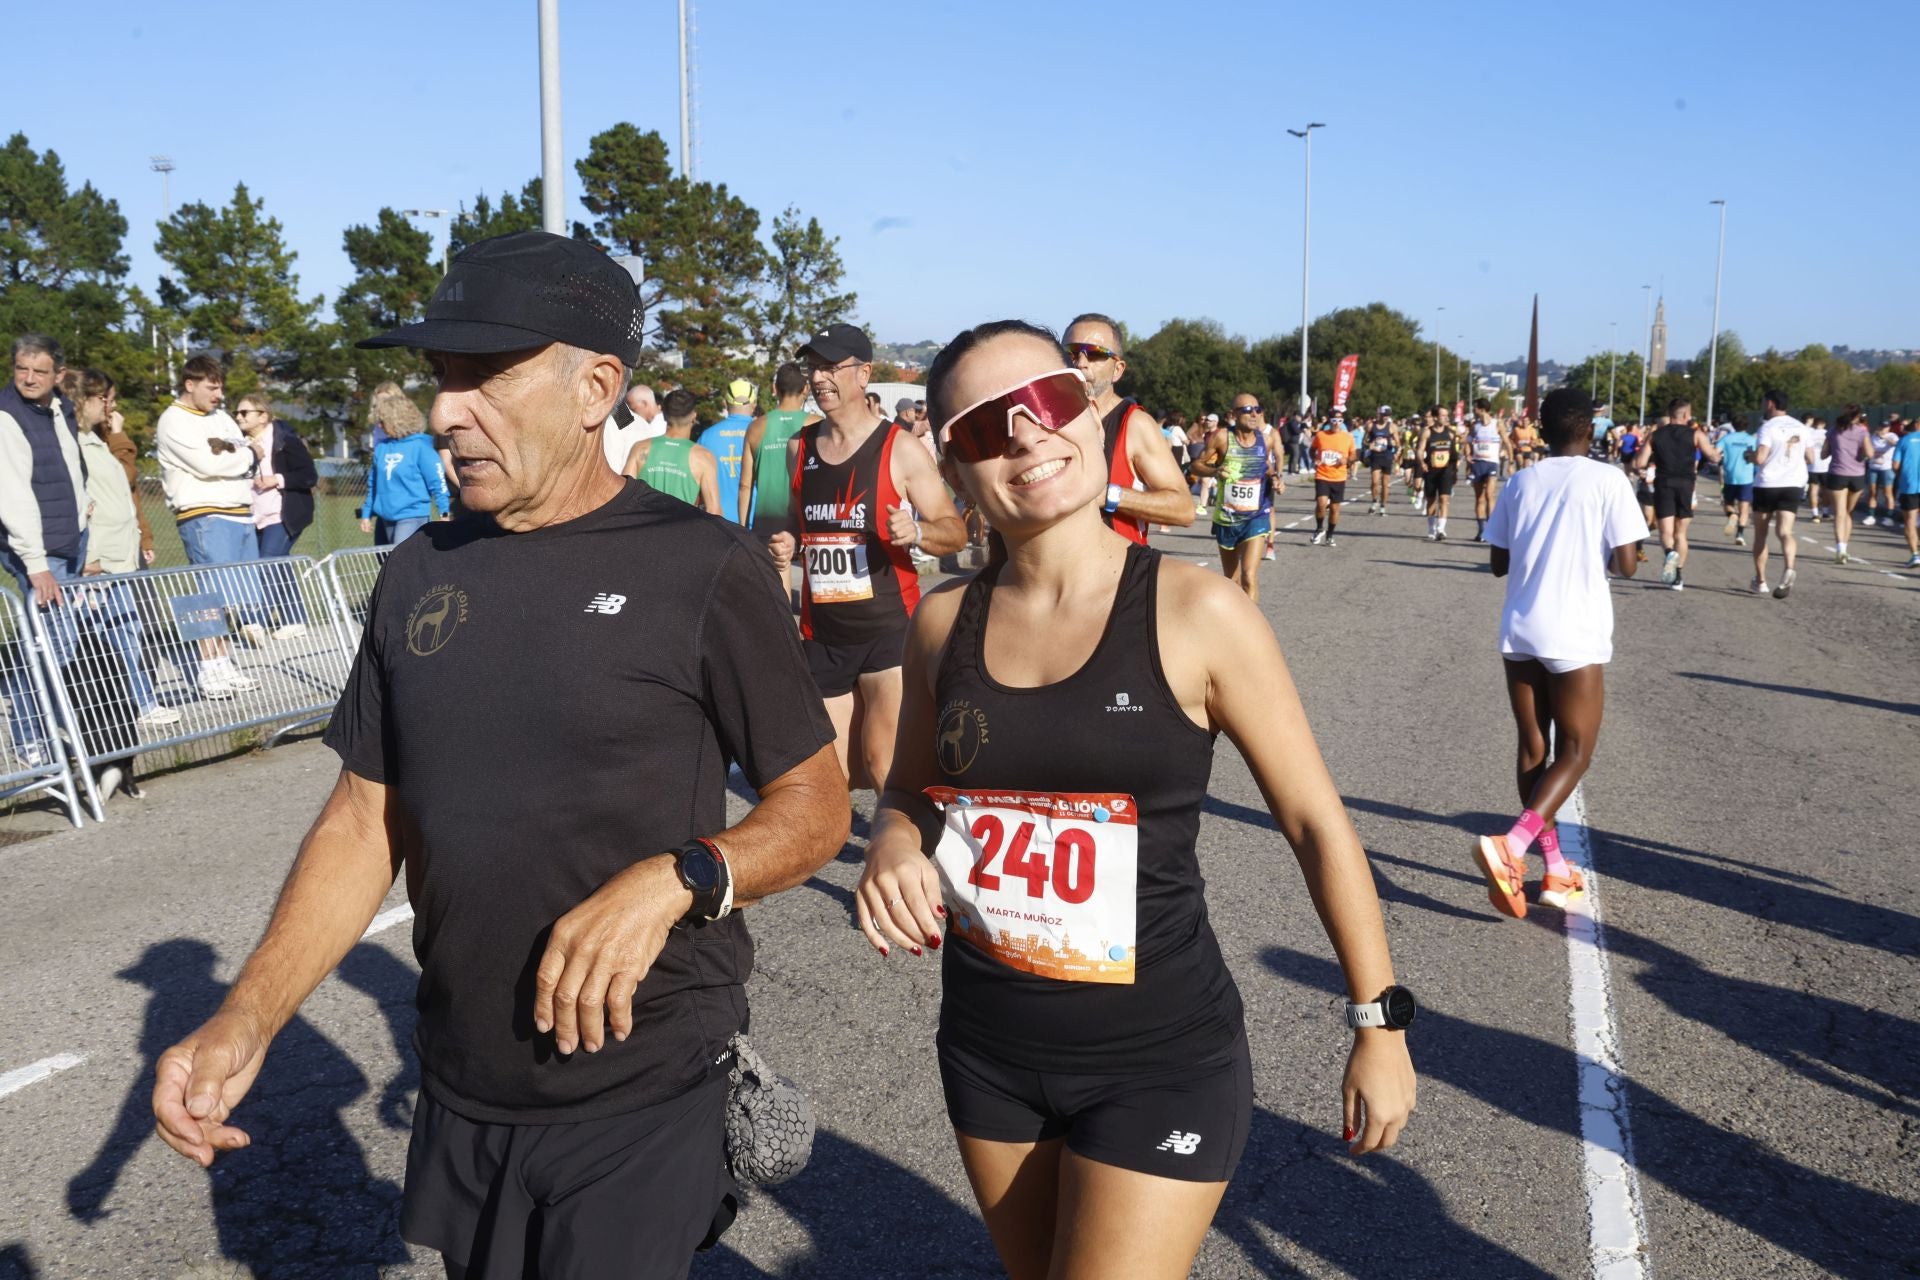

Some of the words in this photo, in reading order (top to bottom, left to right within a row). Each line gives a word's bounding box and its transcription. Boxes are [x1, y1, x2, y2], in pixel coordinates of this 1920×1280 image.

[1231, 486, 1254, 499] 556
[840, 519, 866, 529] AVILES
[809, 547, 858, 576] 2001
[456, 590, 469, 624] COJAS
[973, 708, 990, 744] COJAS
[968, 814, 1097, 905] 240
[986, 905, 1021, 919] MARTA
[1023, 912, 1063, 926] MUÑOZ
